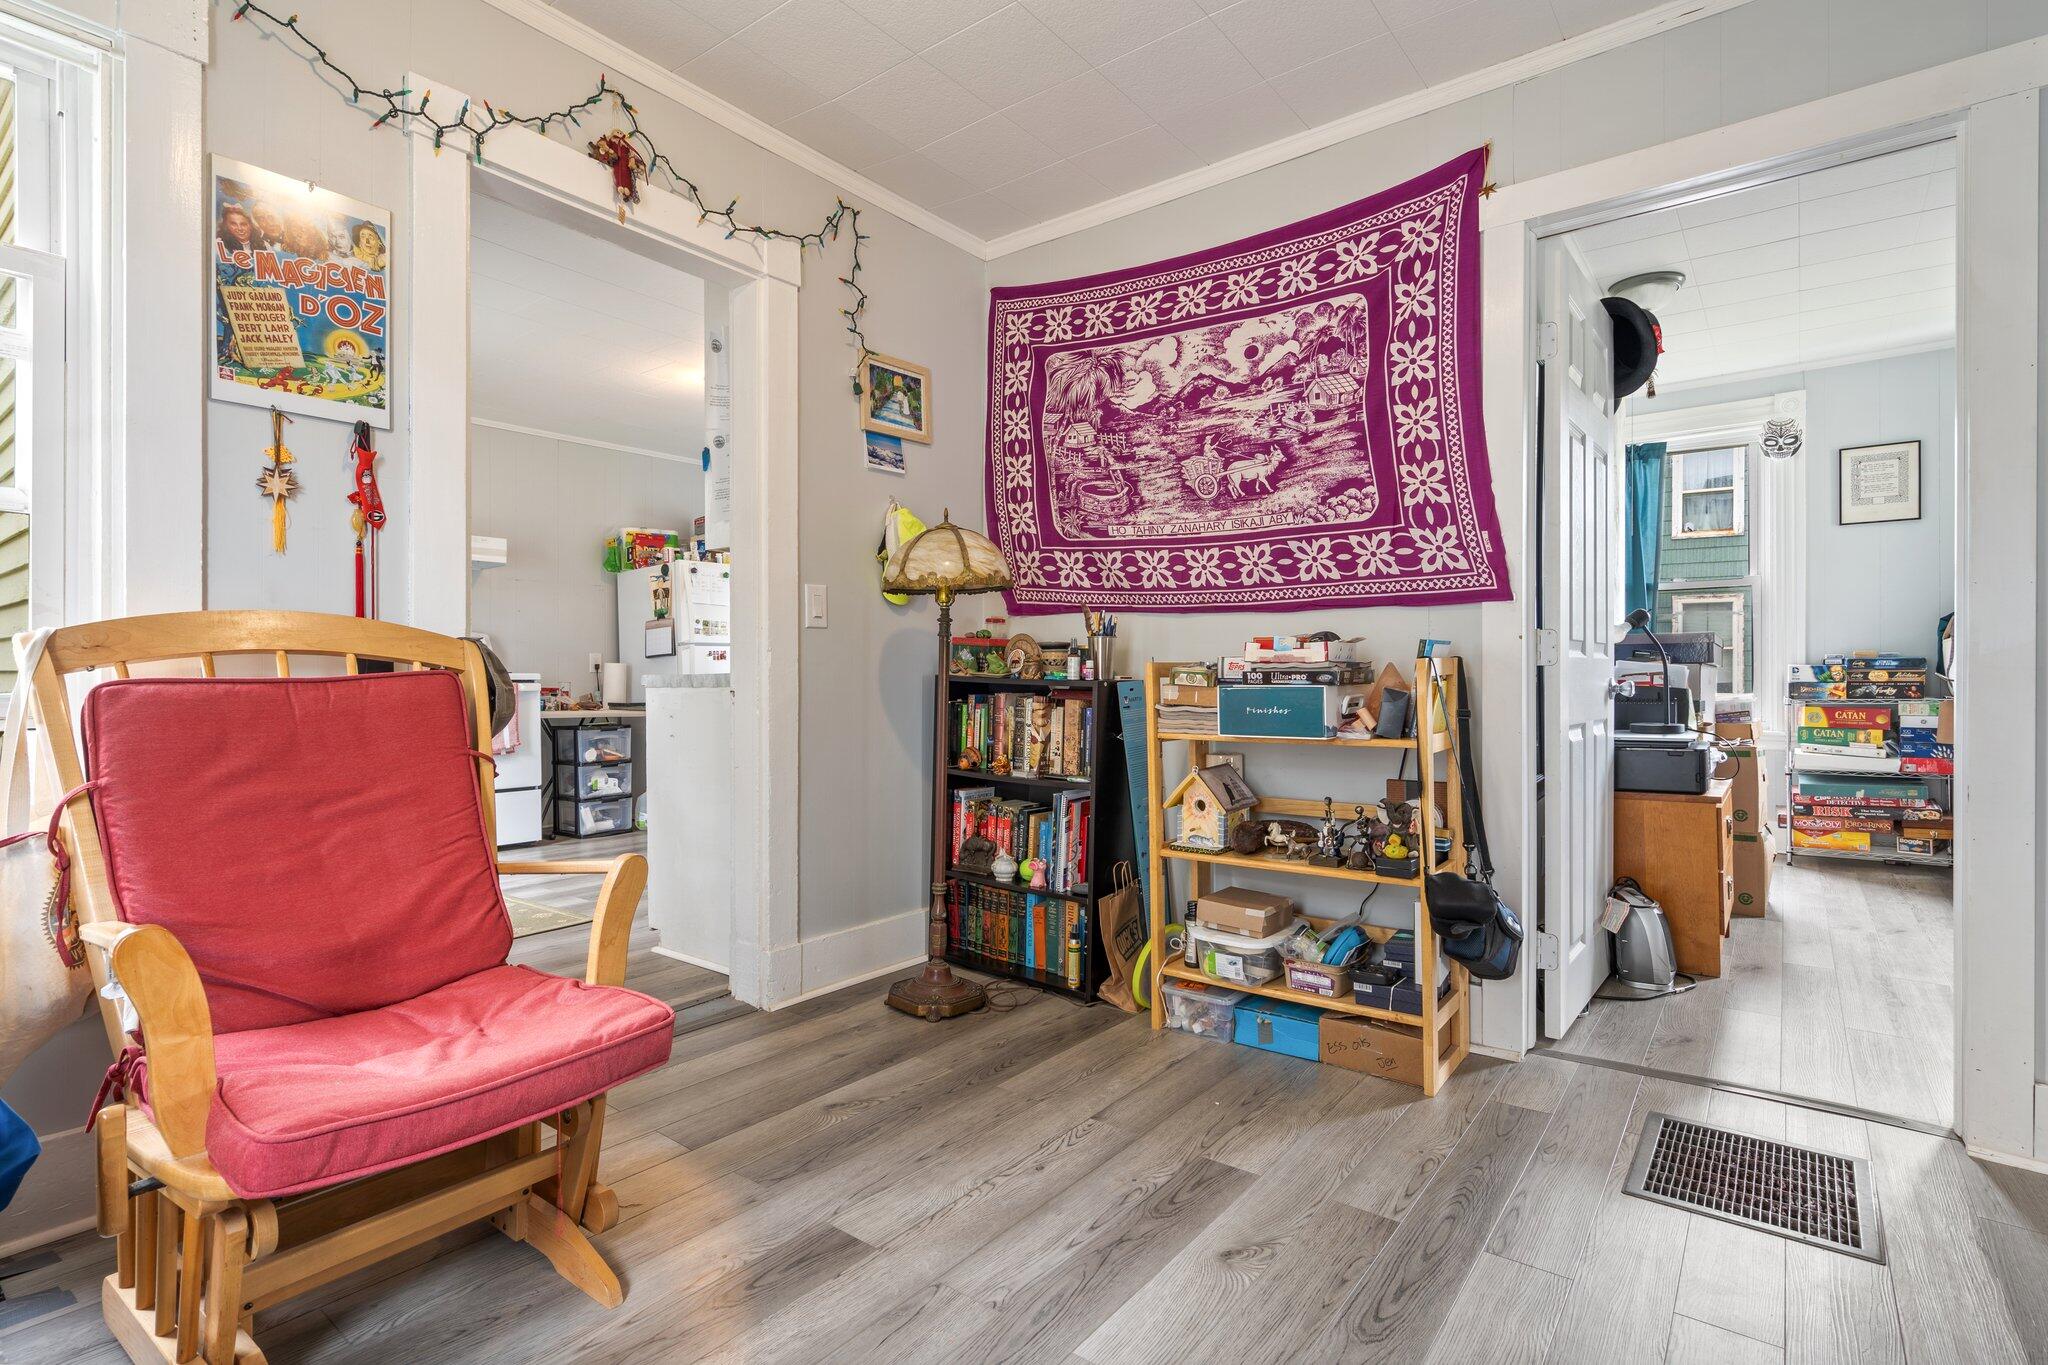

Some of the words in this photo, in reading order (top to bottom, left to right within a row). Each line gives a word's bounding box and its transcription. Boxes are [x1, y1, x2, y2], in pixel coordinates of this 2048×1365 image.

[256, 250, 386, 299] MAGICIEN
[227, 291, 246, 300] JUDY
[249, 291, 282, 301] GARLAND
[229, 302, 255, 311] FRANK
[256, 302, 285, 311] MORGAN
[234, 312, 251, 321] RAY
[253, 313, 286, 322] BOLGER
[299, 294, 386, 336] D'OZ
[237, 324, 262, 332] BERT
[264, 324, 290, 333] LAHR
[240, 334, 263, 343] JACK
[264, 334, 293, 343] HALEY
[1111, 526, 1127, 535] HO
[1131, 525, 1165, 534] TAHINY
[1170, 521, 1227, 534] ZANAHARY
[1269, 513, 1289, 525] ABY
[1247, 672, 1263, 680] 100
[1246, 705, 1291, 715] Finishes
[1835, 710, 1866, 719] CATAN
[1813, 728, 1844, 737] CATAN
[1812, 806, 1853, 817] RISK
[1794, 819, 1842, 829] MONOPOLY
